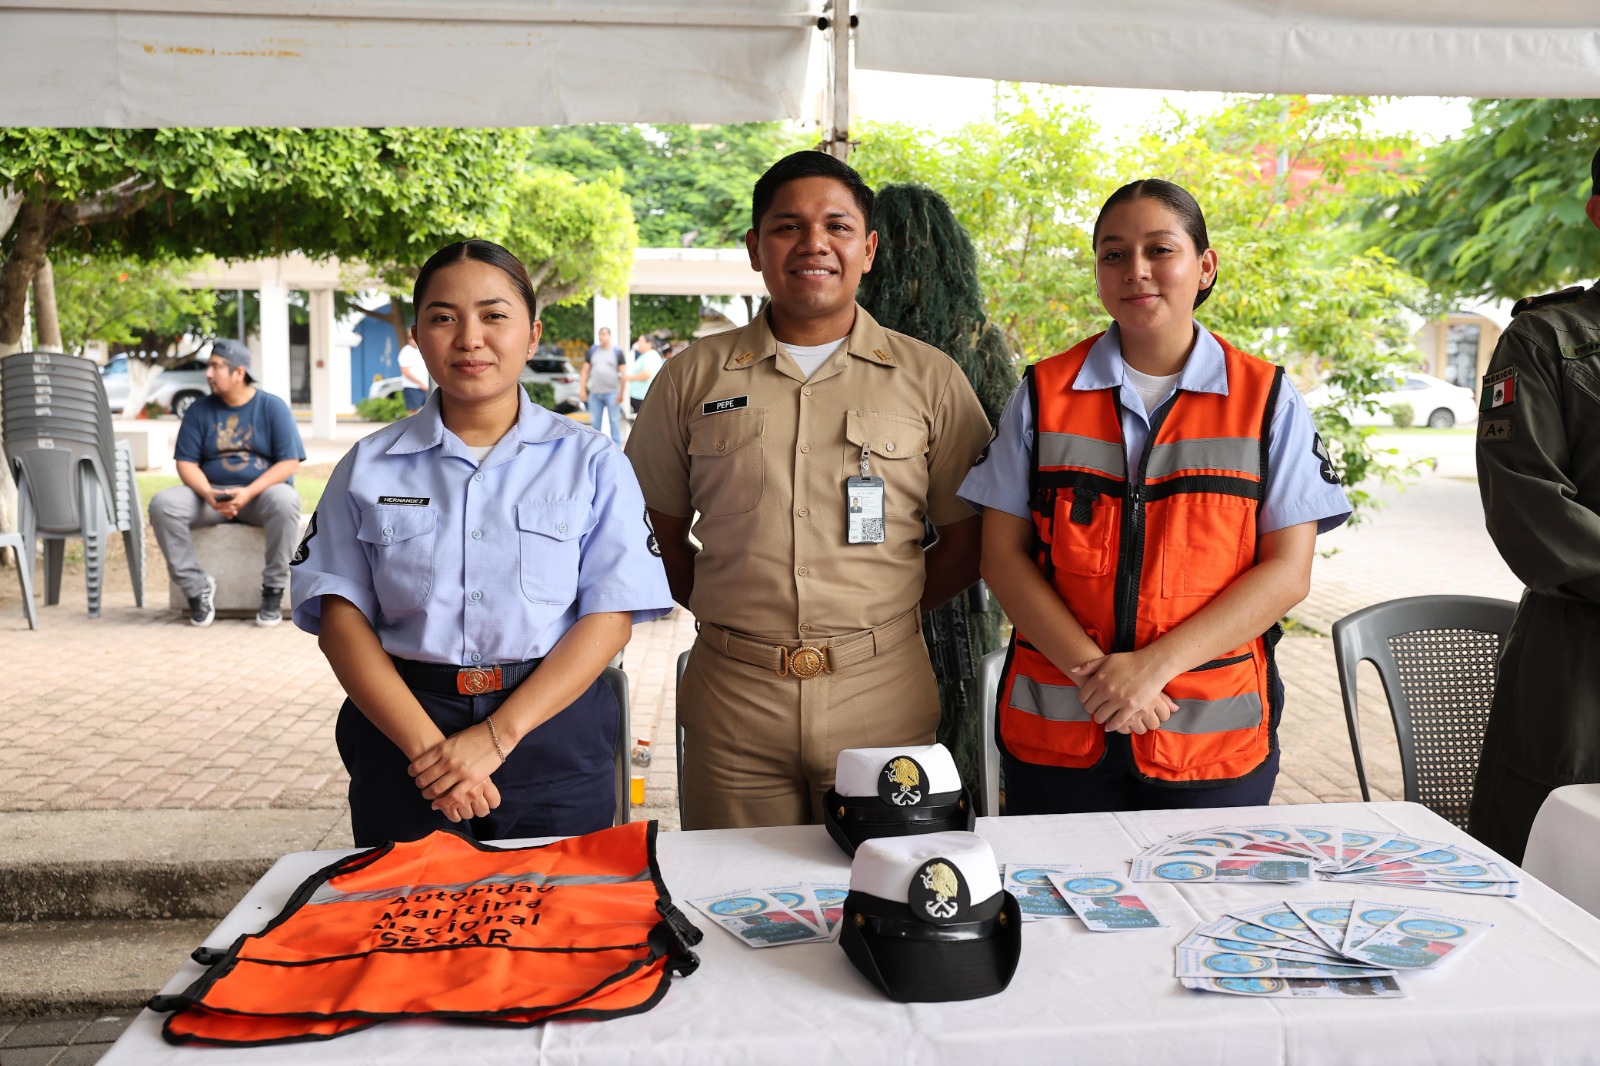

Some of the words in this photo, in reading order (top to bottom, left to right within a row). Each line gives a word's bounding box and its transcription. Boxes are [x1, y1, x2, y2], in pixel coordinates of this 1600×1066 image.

[1484, 368, 1514, 386] MÉXICO
[716, 400, 735, 410] PEPE
[1485, 423, 1505, 437] A+
[388, 884, 557, 905] Autoridad
[372, 912, 541, 936] Nacional
